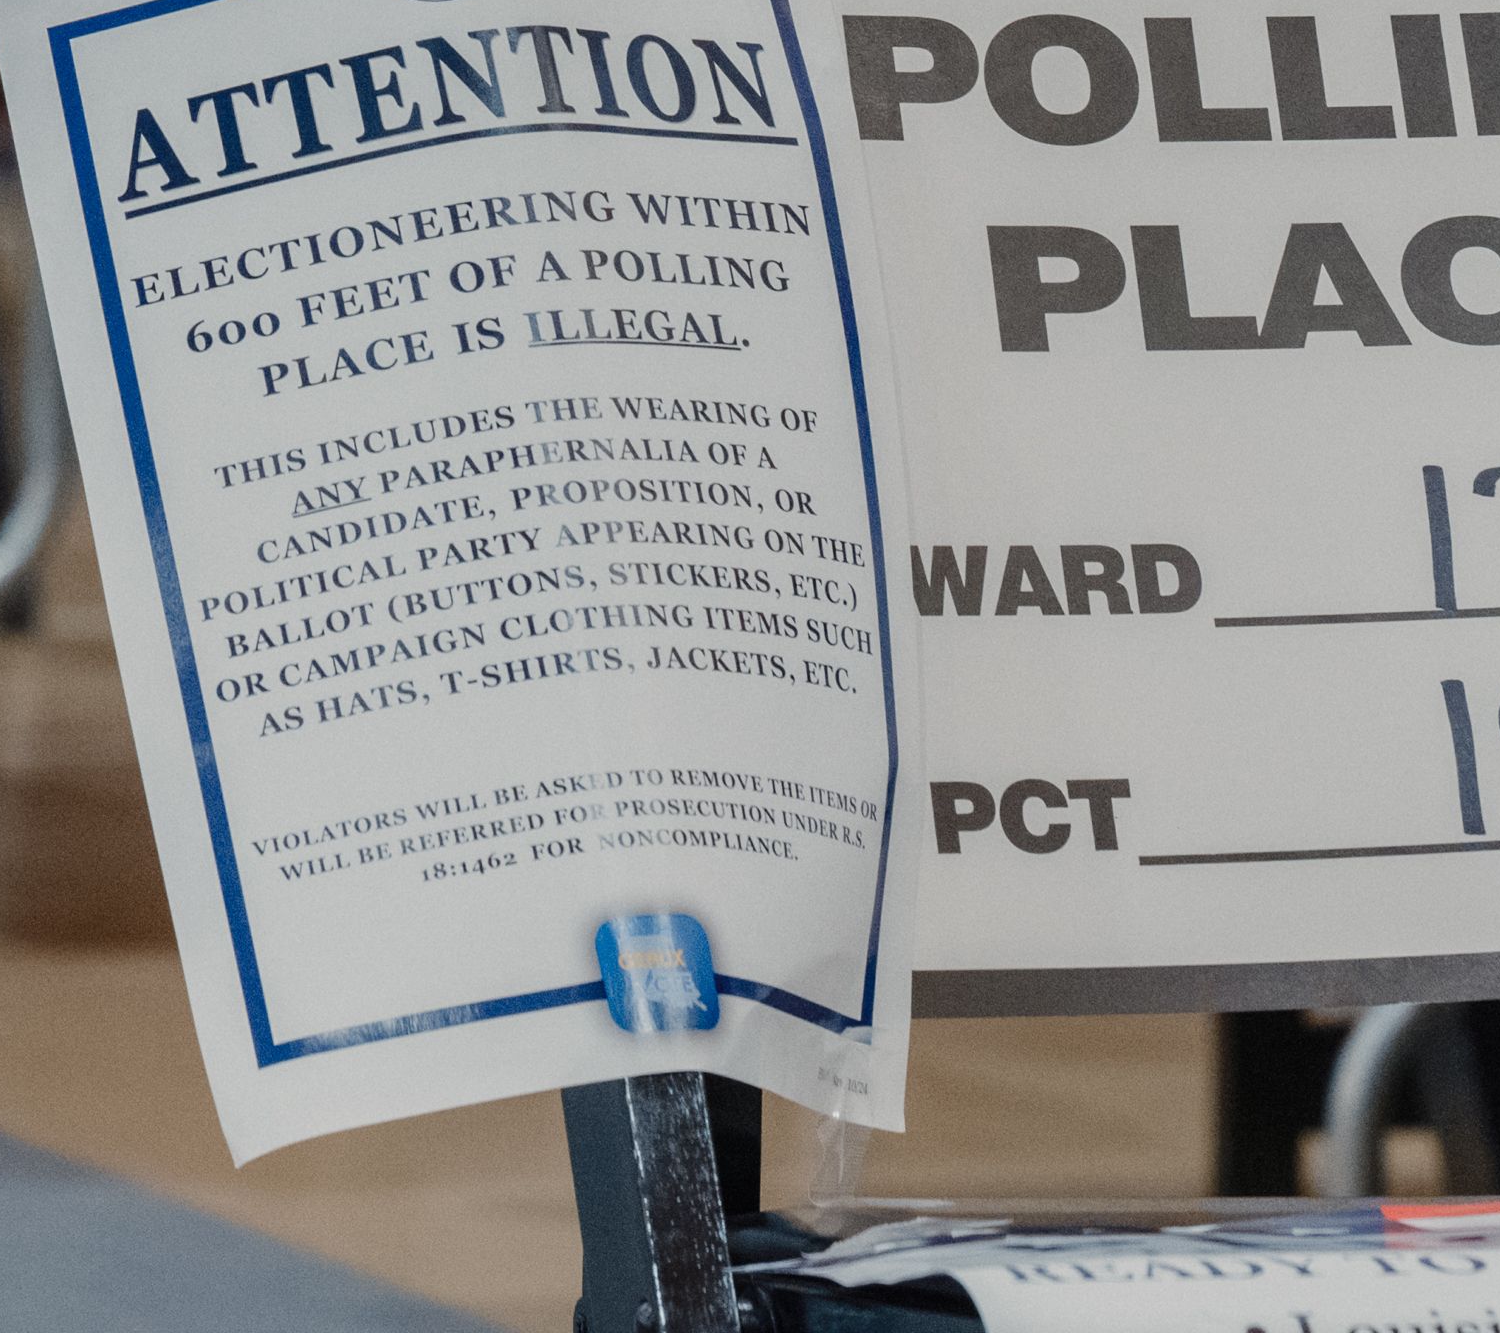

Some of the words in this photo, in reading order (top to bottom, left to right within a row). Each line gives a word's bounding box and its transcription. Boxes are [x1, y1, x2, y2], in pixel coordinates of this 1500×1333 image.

[117, 24, 776, 203] ATTENTION
[131, 191, 614, 307] ELECTIONEERING
[627, 193, 809, 236] WITHIN
[186, 311, 281, 352] 600
[297, 270, 430, 327] FEET
[450, 255, 515, 293] OF
[537, 251, 571, 282] A
[581, 250, 789, 292] POLLING
[259, 331, 434, 396] PLACE
[453, 317, 505, 354] IS
[523, 309, 751, 347] ILLEGAL.
[214, 449, 306, 487] THIS
[319, 406, 515, 464] INCLUDES
[525, 397, 602, 423] THE
[611, 397, 770, 427] WEARING
[781, 408, 817, 432] OF
[293, 475, 370, 513] ANY
[380, 439, 699, 493] PARAPHERNALIA
[708, 443, 746, 466] OF
[758, 447, 777, 469] A
[257, 498, 496, 563] CANDIDATE,
[511, 479, 763, 512] PROPOSITION,
[775, 489, 816, 515] OR
[200, 556, 406, 621] POLITICAL
[418, 528, 539, 570] PARTY
[555, 520, 754, 550] APPEARING
[764, 529, 804, 555] ON
[811, 535, 865, 567] THE
[227, 603, 373, 657] BALLOT
[388, 568, 597, 622] (BUTTONS,
[609, 563, 781, 597] STICKERS,
[790, 574, 857, 611] ETC.)
[911, 542, 1202, 618] WARD
[216, 673, 269, 701] OR
[279, 624, 485, 687] CAMPAIGN
[500, 605, 693, 640] CLOTHING
[704, 607, 798, 638] ITEMS
[806, 619, 872, 655] SUCH
[261, 707, 304, 736] AS
[316, 682, 430, 723] HATS,
[440, 648, 634, 694] T-SHIRTS,
[647, 647, 795, 684] JACKETS,
[803, 660, 856, 693] ETC.
[252, 809, 407, 855] VIOLATORS
[415, 794, 486, 819] WILL
[494, 785, 528, 805] BE
[630, 770, 663, 785] TO
[671, 770, 763, 792] REMOVE
[768, 778, 805, 800] THE
[809, 786, 857, 814] ITEMS
[861, 800, 877, 822] OR
[280, 854, 350, 880] WILL
[358, 843, 391, 864] BE
[400, 814, 544, 855] REFERRED
[554, 803, 605, 825] FOR
[615, 800, 775, 824] PROSECUTION
[782, 810, 838, 840] UNDER
[843, 826, 865, 849] R.S.
[422, 851, 517, 882] 18:1462
[531, 838, 583, 860] FOR
[599, 828, 799, 861] NONCOMPLIANCE.
[929, 778, 1131, 854] PCT
[1004, 1251, 1316, 1284] READY
[1368, 1252, 1488, 1276] TO
